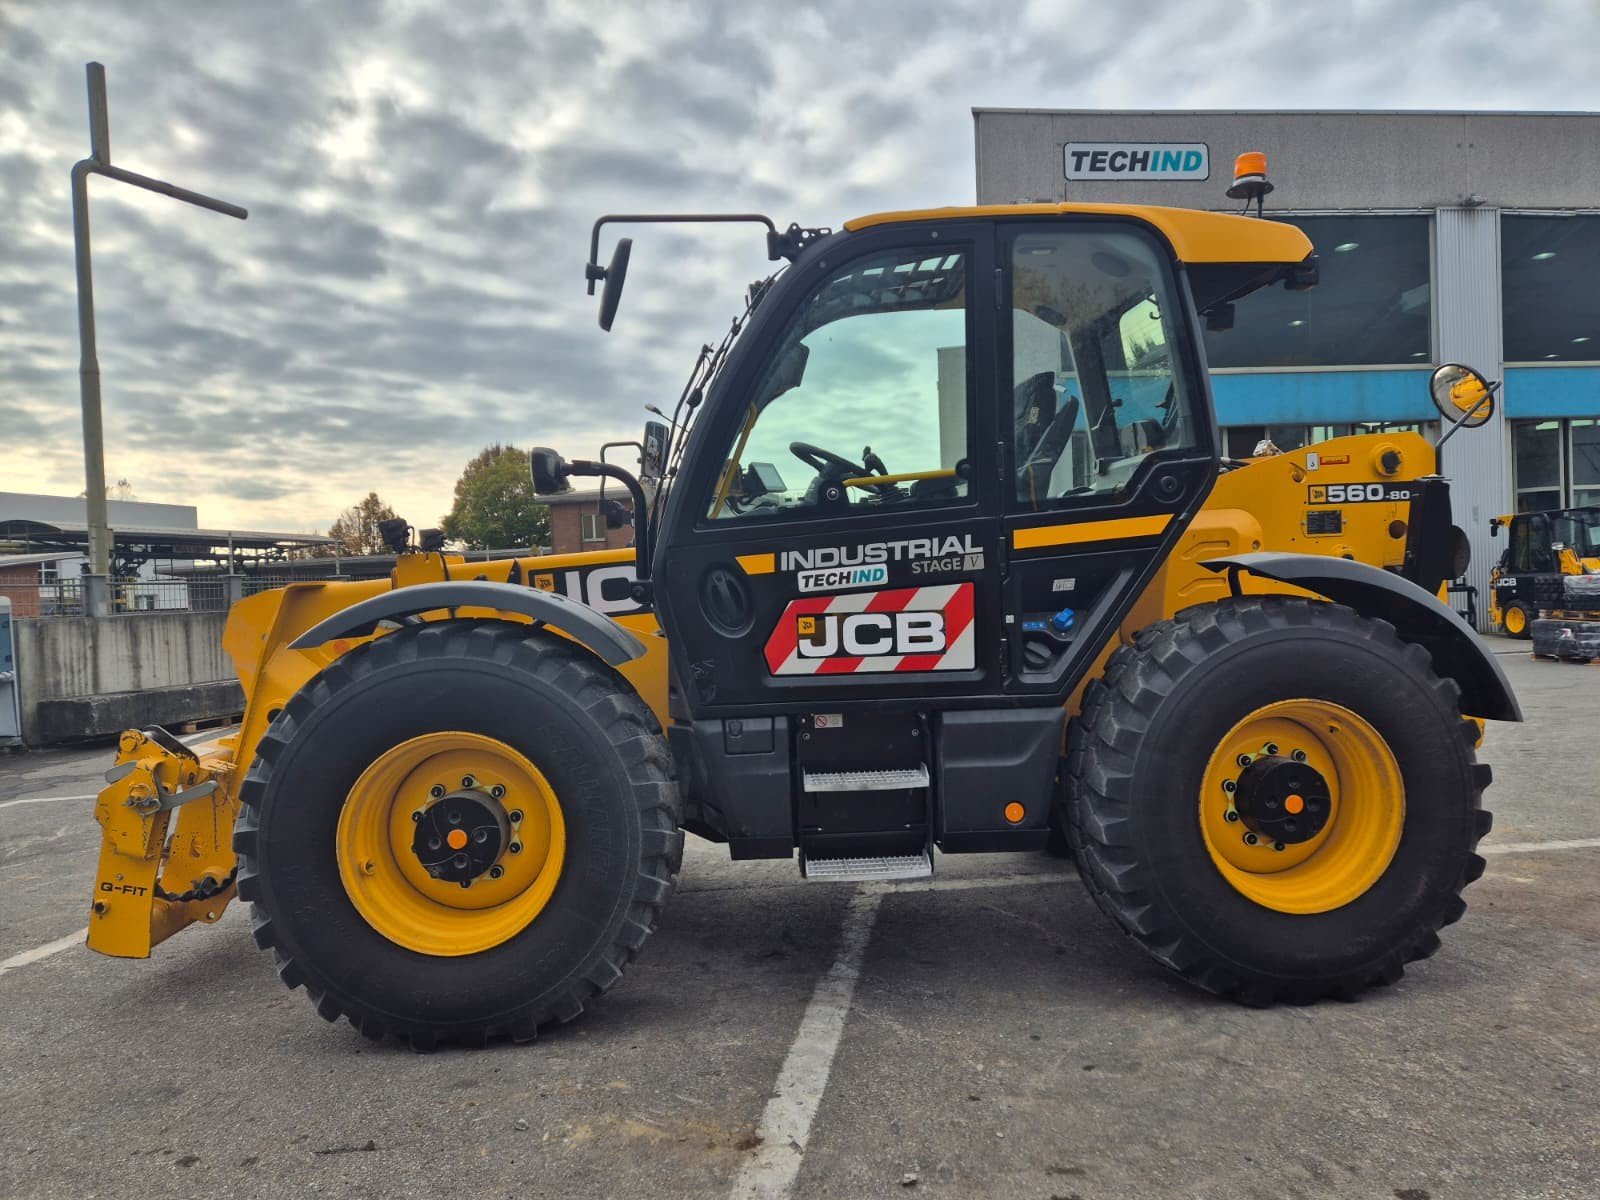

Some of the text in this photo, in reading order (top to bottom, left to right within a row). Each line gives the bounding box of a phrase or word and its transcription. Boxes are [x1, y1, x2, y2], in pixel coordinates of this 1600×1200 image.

[1071, 150, 1203, 173] TECHIND
[780, 534, 984, 572] INDUSTRIAL
[911, 557, 961, 574] STAGE
[802, 567, 886, 589] TECHIND
[1497, 577, 1517, 587] JCB
[798, 611, 946, 658] JCB
[101, 882, 148, 897] Q-FIT
